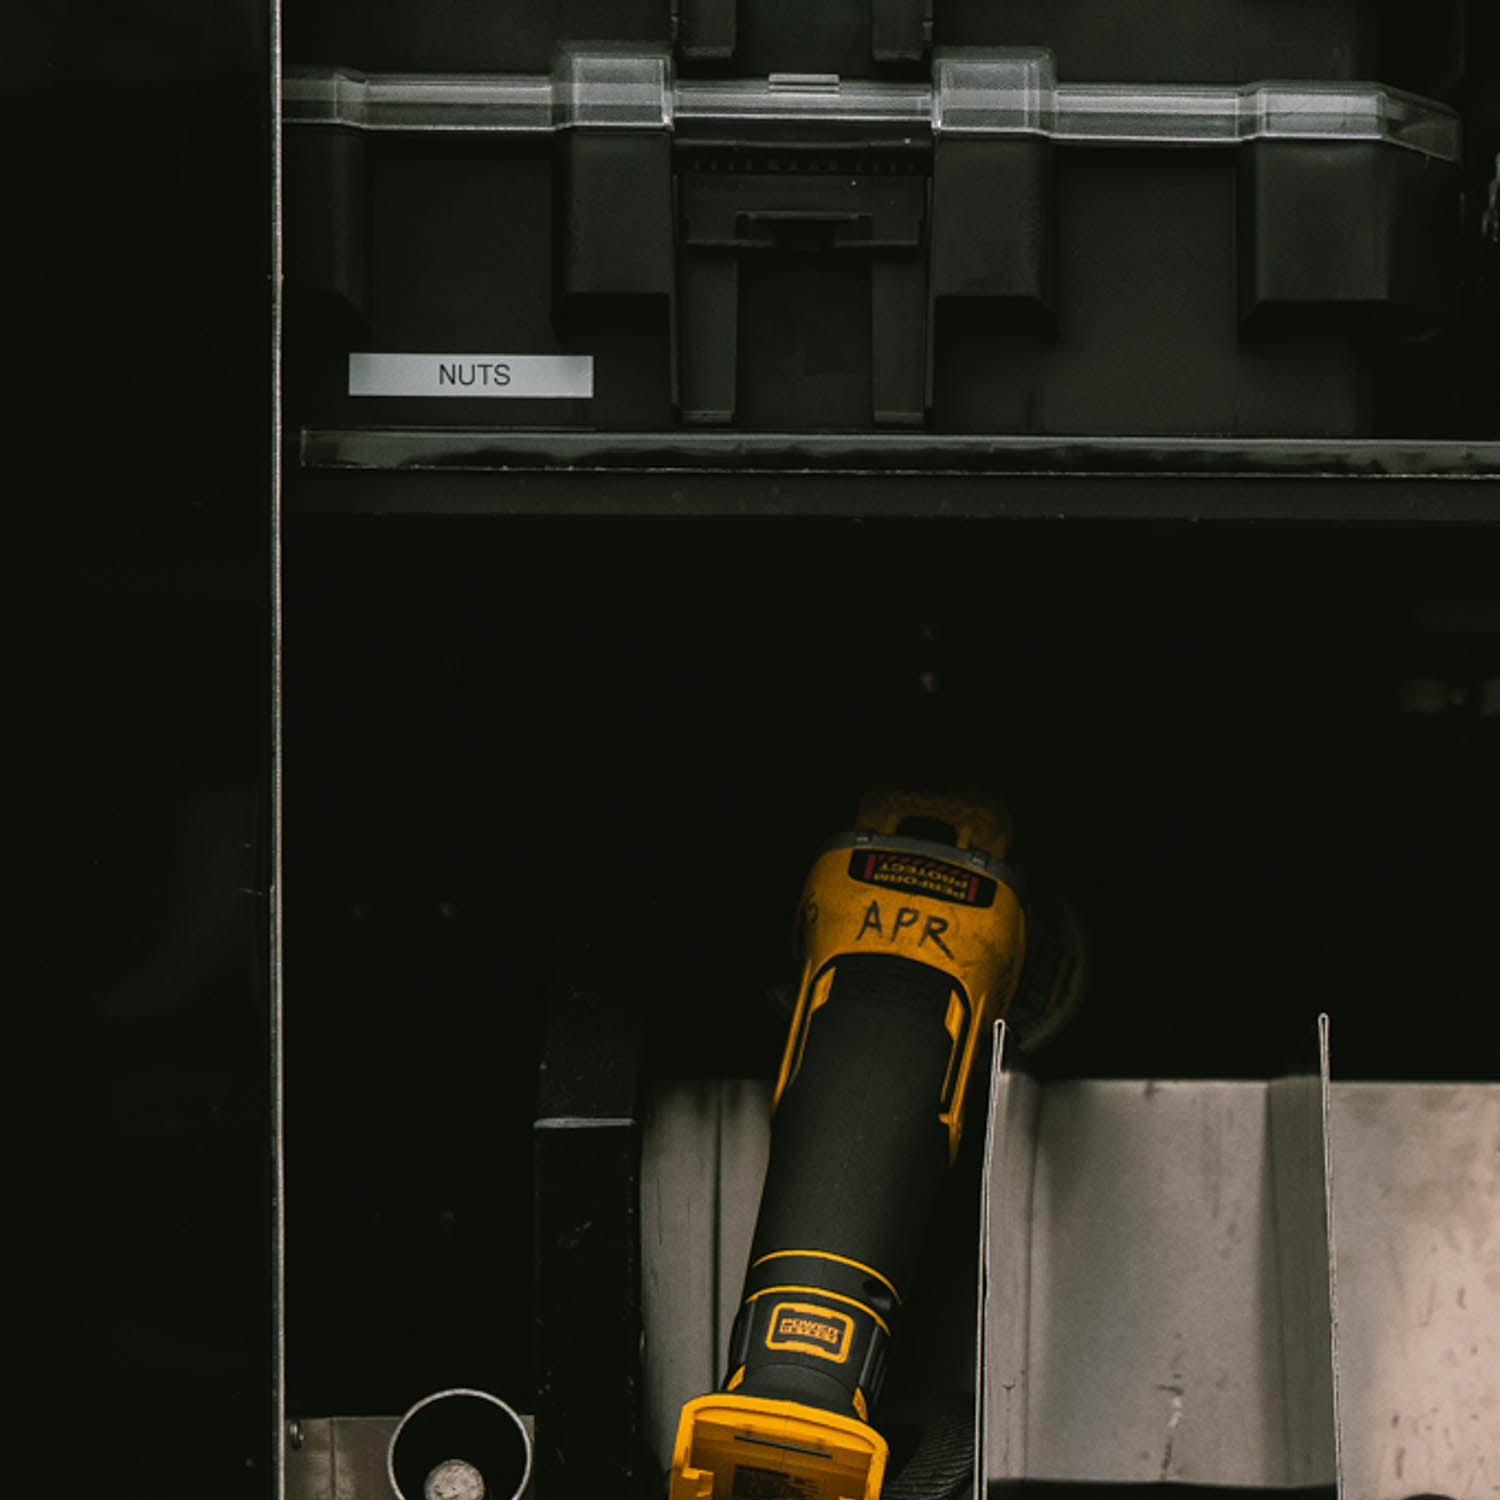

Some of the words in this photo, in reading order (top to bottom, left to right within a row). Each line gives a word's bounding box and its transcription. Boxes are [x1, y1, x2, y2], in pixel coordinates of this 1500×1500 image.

[438, 363, 511, 385] NUTS
[879, 861, 969, 888] PROTECT
[856, 899, 954, 961] APR
